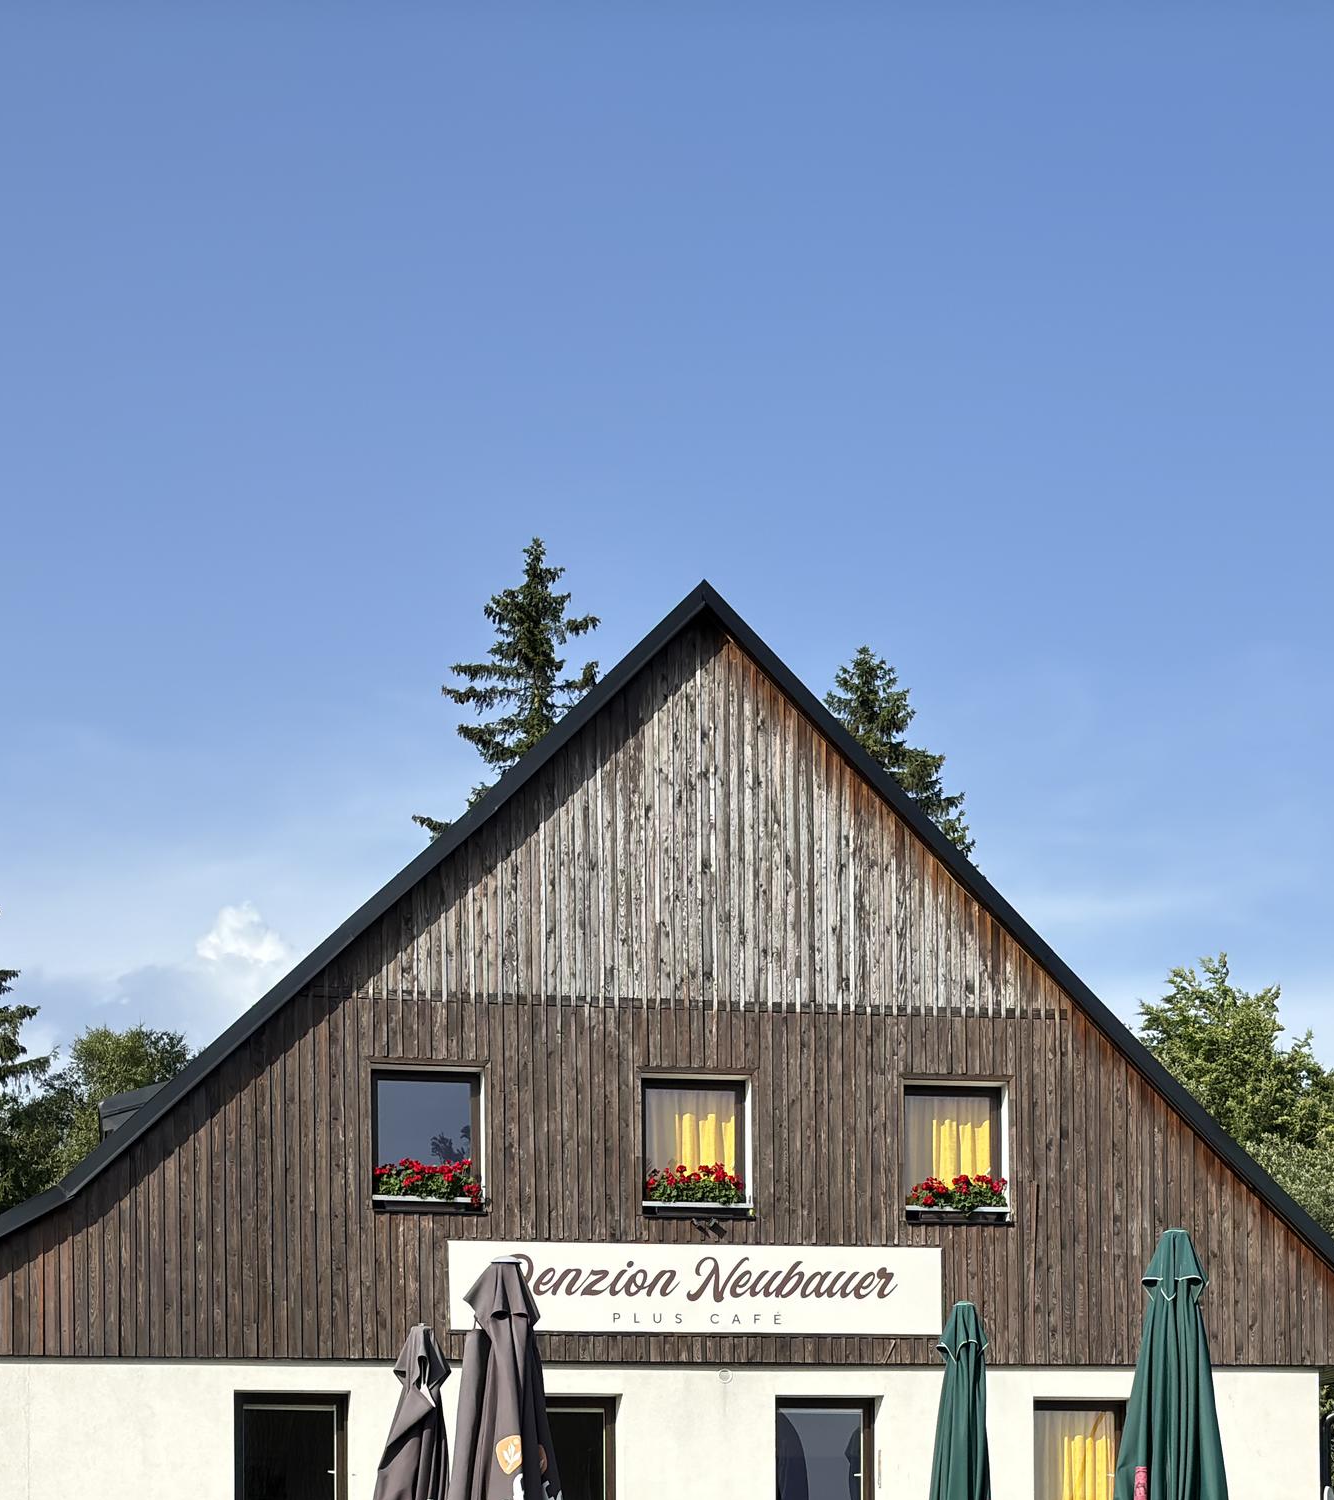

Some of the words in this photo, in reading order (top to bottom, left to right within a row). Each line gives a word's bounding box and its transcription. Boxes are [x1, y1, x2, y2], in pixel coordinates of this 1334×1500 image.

[686, 1256, 898, 1303] Neubauer
[612, 1312, 683, 1325] PLUS
[710, 1311, 782, 1325] CAFÉ
